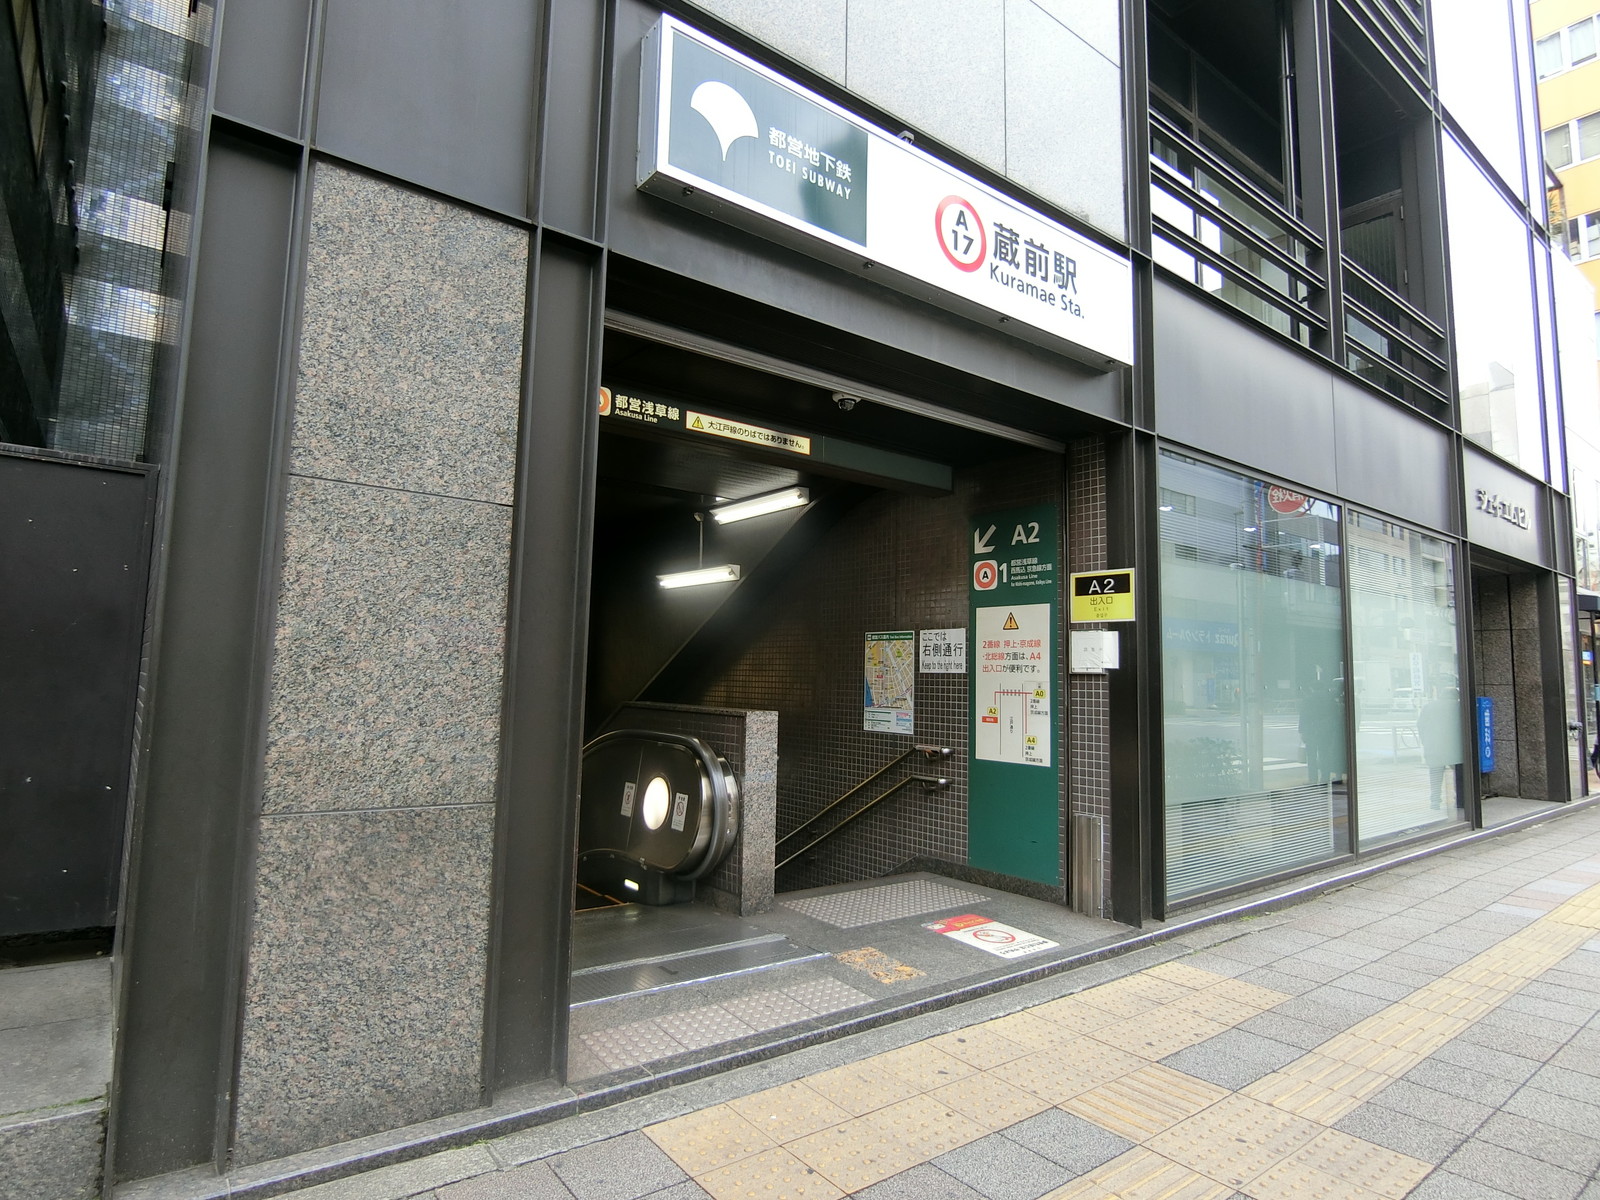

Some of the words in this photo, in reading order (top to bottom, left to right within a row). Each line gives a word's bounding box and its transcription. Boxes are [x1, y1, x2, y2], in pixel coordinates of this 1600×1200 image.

[768, 126, 852, 183] 都営地下鉄
[768, 150, 797, 175] TOEI
[801, 166, 852, 200] SUBWAY
[955, 209, 969, 231] A
[951, 229, 975, 256] 17
[993, 221, 1078, 295] 蔵前駅
[990, 262, 1056, 307] Kuramae
[1060, 293, 1086, 319] Sta.
[614, 408, 643, 420] Asakusa
[644, 413, 658, 424] Line
[615, 393, 680, 421] 都営浅草線
[707, 420, 805, 449] 大江戸線のりばではありません。
[1010, 521, 1040, 546] A2
[981, 570, 989, 580] A
[998, 562, 1008, 583] 1
[1088, 578, 1115, 594] A2
[1089, 596, 1113, 606] 出入口
[922, 632, 947, 641] ここでは
[982, 640, 1001, 649] 2番線
[922, 643, 963, 657] 右側通行
[982, 664, 1041, 674] 出入口が便利です。
